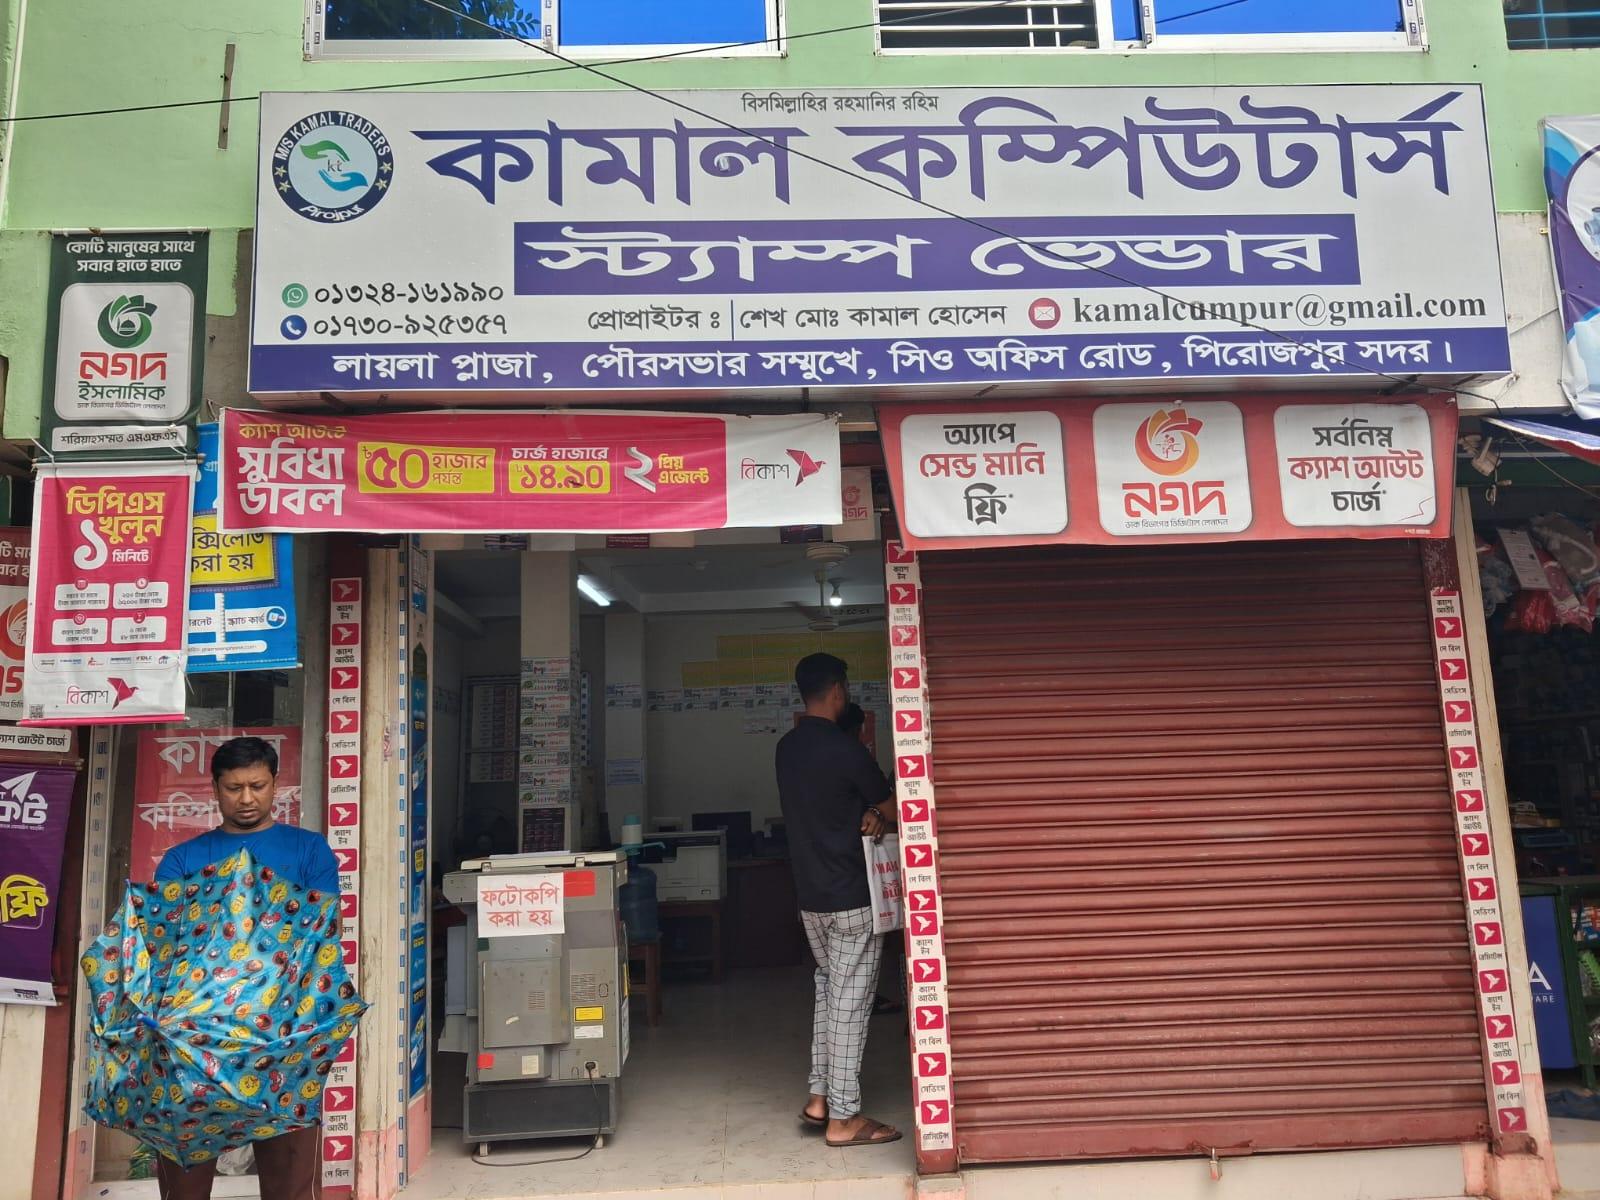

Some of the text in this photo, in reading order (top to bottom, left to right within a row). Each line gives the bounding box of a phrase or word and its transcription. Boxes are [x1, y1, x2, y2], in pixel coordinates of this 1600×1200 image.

[741, 91, 939, 114] বিসমিল্লাহির রহমানির রহিম
[290, 111, 335, 140] KAMAL
[338, 111, 391, 156] TRADERS
[410, 92, 1464, 206] কামাল কম্পিউটার্স
[299, 204, 365, 221] Pirojpur
[66, 236, 195, 258] কোটি মানুষের সাথে
[524, 226, 1338, 281] স্ট্যাম্প ভেন্ডার
[77, 259, 182, 273] সবার হাতে হাতে
[315, 283, 504, 306] ০১৩২৪-১৬১৯৯০
[588, 305, 700, 332] প্রোপ্রাইটর
[740, 305, 1007, 328] শেখ মোঃ কামাল হোসেন
[1073, 293, 1487, 328] kamalcumpur@gmail.com
[313, 313, 507, 337] ০১৭৩০-৯২৫৩৫৭
[79, 352, 167, 381] নগদ
[332, 352, 439, 382] লায়লা
[583, 344, 749, 380] পৌরসভার
[888, 340, 953, 374] সিও
[965, 339, 1068, 372] অফিস
[1180, 334, 1349, 372] পিরোজপুর
[78, 381, 166, 401] ইসলামিক
[239, 423, 282, 440] ক্যাশ
[943, 423, 1016, 445] অ্যাপে
[1312, 417, 1393, 447] সর্বনিম্ন
[237, 437, 344, 484] সুবিধা
[432, 452, 488, 470] হাজার
[512, 446, 609, 460] চার্জ হাজারে
[657, 454, 684, 470] প্রিয়
[919, 443, 1046, 479] সেন্ড মানি
[1287, 449, 1424, 480] ক্যাশ আউট
[432, 470, 462, 486] পর্যন্ত
[624, 446, 656, 494] ২
[657, 468, 710, 484] এজেন্টে
[740, 457, 790, 480] বিকাশ
[66, 485, 166, 514] ডিপিএস
[237, 482, 346, 516] ডাবল
[1122, 481, 1227, 517] নগদ
[98, 515, 164, 544] খুলুন
[74, 519, 108, 570] ১
[112, 548, 149, 562] মিনিটে
[227, 553, 254, 571] হয়
[67, 685, 109, 704] বিকাশ
[18, 733, 45, 745] আউট
[46, 734, 67, 746] চার্জ
[481, 882, 560, 906] ফটোকপি
[486, 909, 553, 928] করা হয়
